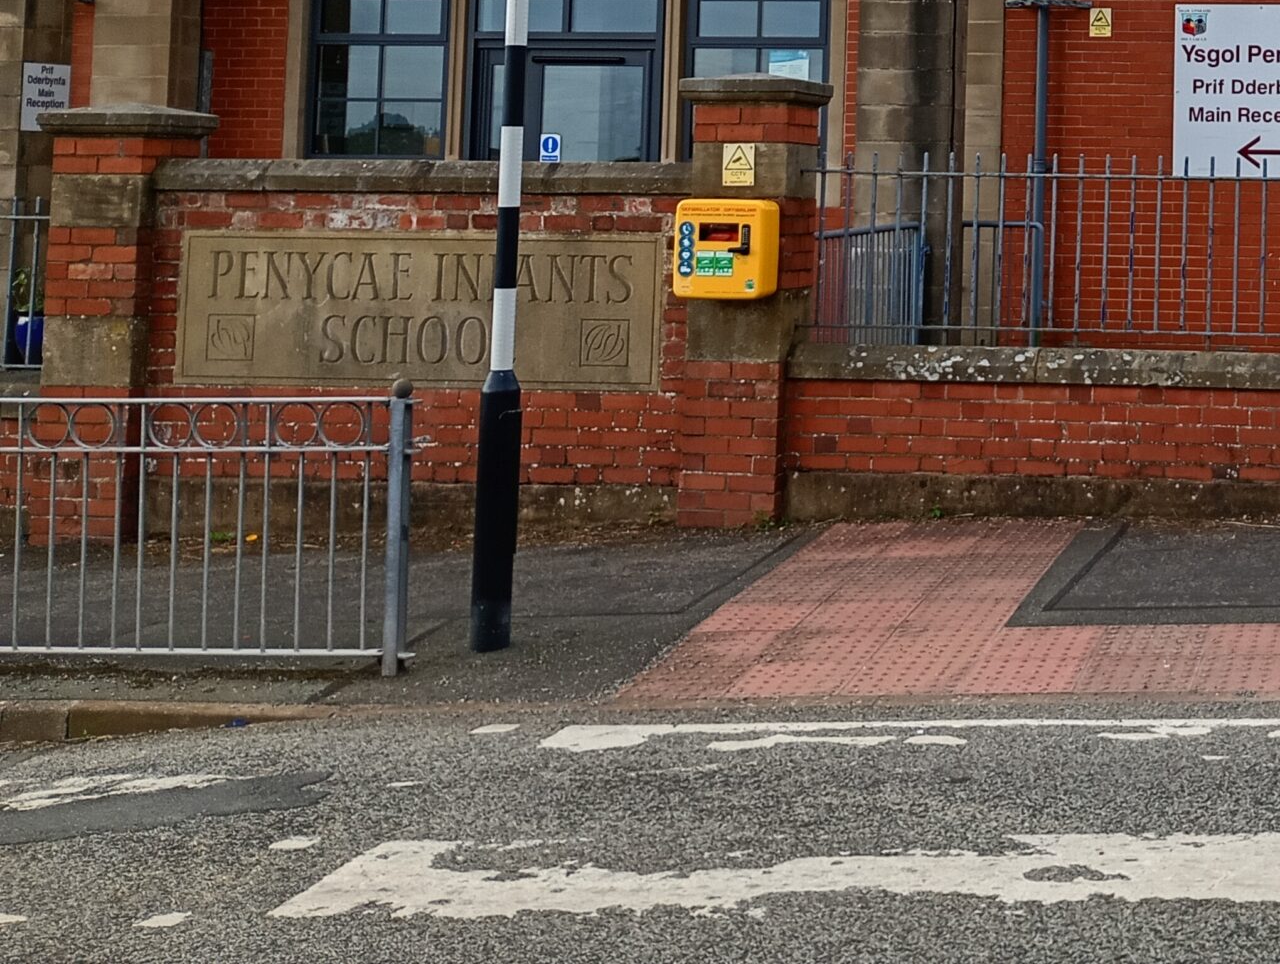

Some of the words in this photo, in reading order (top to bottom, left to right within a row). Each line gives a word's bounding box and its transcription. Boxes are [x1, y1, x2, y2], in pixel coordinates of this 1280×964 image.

[1182, 44, 1241, 68] Ysgol
[41, 65, 54, 75] Prif
[27, 75, 66, 87] Dderbynfa
[1192, 78, 1225, 95] Prif
[38, 88, 55, 98] Main
[26, 98, 65, 111] Reception
[1188, 106, 1231, 123] Main
[207, 250, 414, 303] PENYCAE
[431, 253, 634, 305] INANTS
[318, 314, 516, 366] SCHOO
